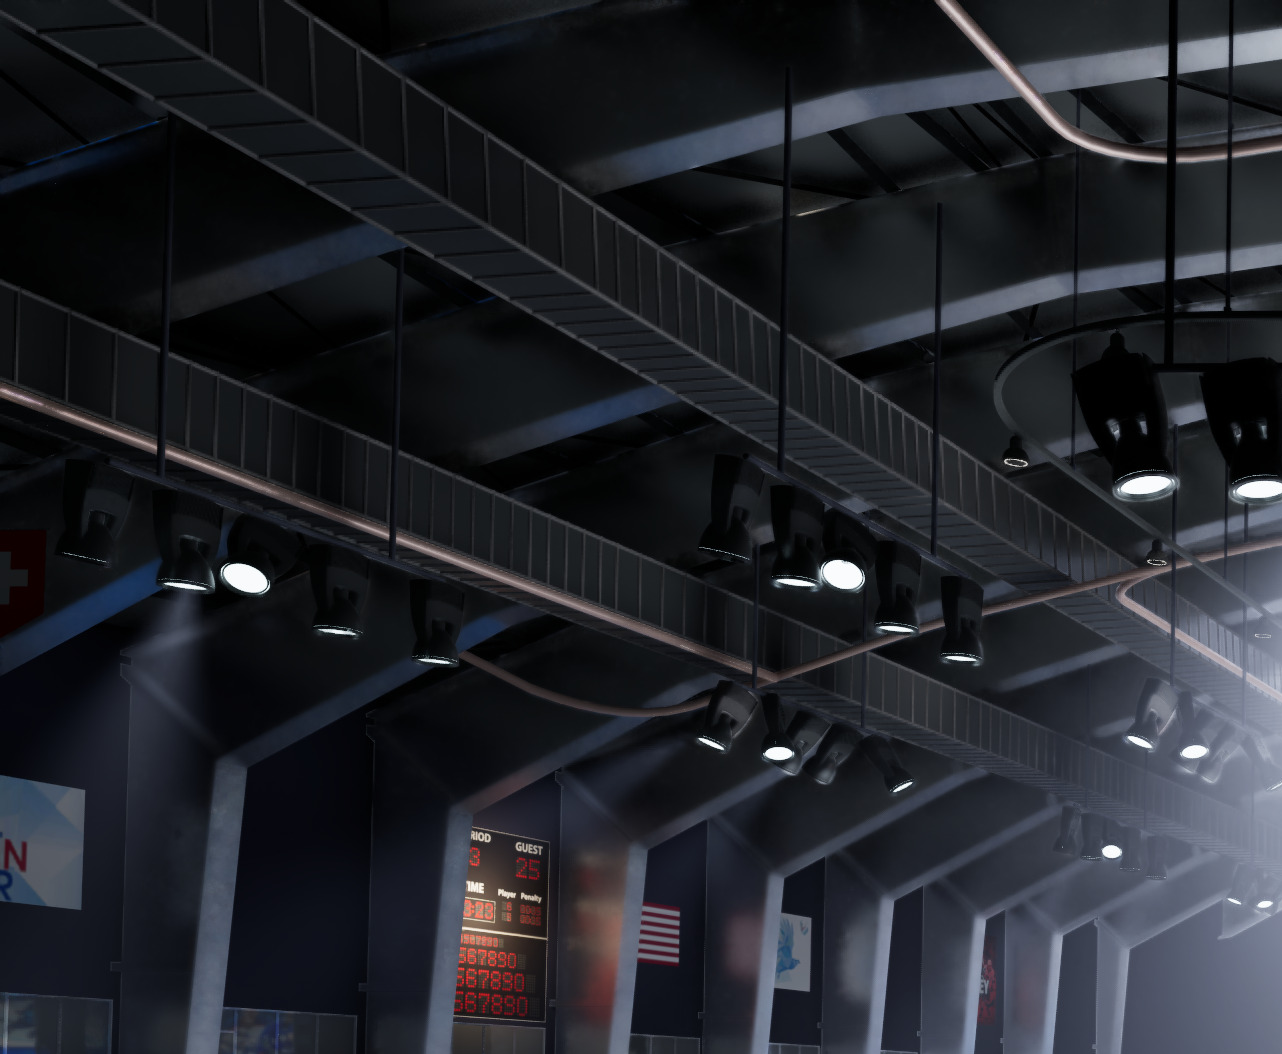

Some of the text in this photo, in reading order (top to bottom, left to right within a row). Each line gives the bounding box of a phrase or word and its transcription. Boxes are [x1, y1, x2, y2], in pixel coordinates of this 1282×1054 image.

[471, 830, 492, 843] RIOD
[515, 842, 544, 855] GUEST
[515, 857, 541, 880] 25
[498, 888, 542, 904] Player Penalty
